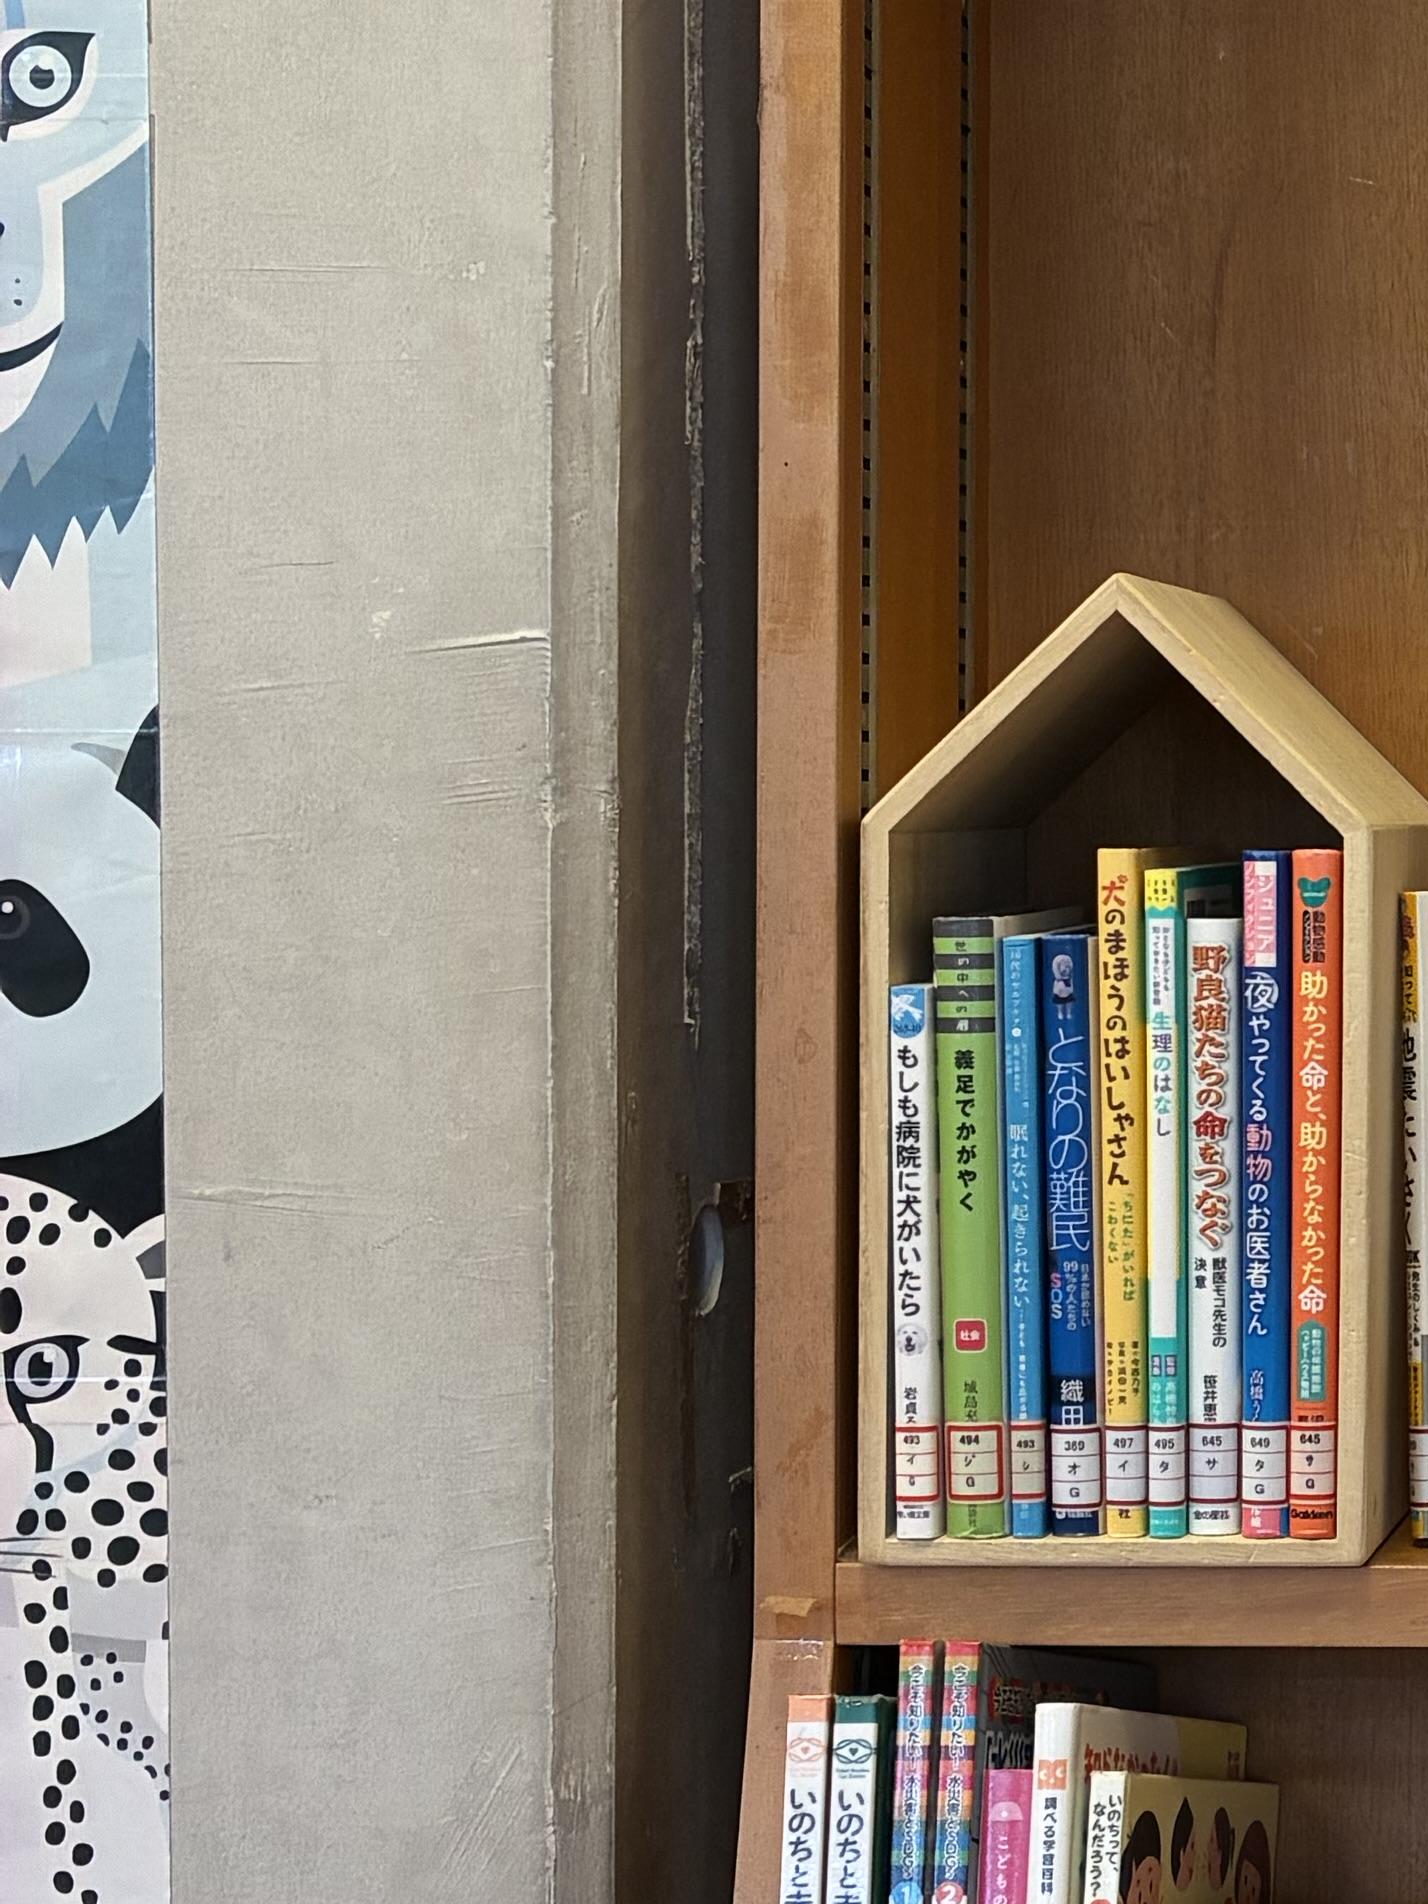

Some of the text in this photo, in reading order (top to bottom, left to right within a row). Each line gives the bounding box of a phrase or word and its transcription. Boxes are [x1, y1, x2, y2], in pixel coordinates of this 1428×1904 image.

[954, 1049, 978, 1212] 義足でかがやく
[1046, 1027, 1091, 1252] となりの難民
[1101, 878, 1135, 1187] 犬のまほうのはいしゃさん
[1150, 1010, 1173, 1137] 生理のはなし
[1190, 944, 1233, 1252] 野良猫たちの命をつなぐ
[1244, 972, 1277, 1336] 夜やってくる動物のお医者さん
[1298, 970, 1328, 1315] 助かった命と、助からなかった命
[895, 1045, 923, 1317] もしも病院に犬がいたら
[1211, 1257, 1228, 1348] 獣医モコ先生の
